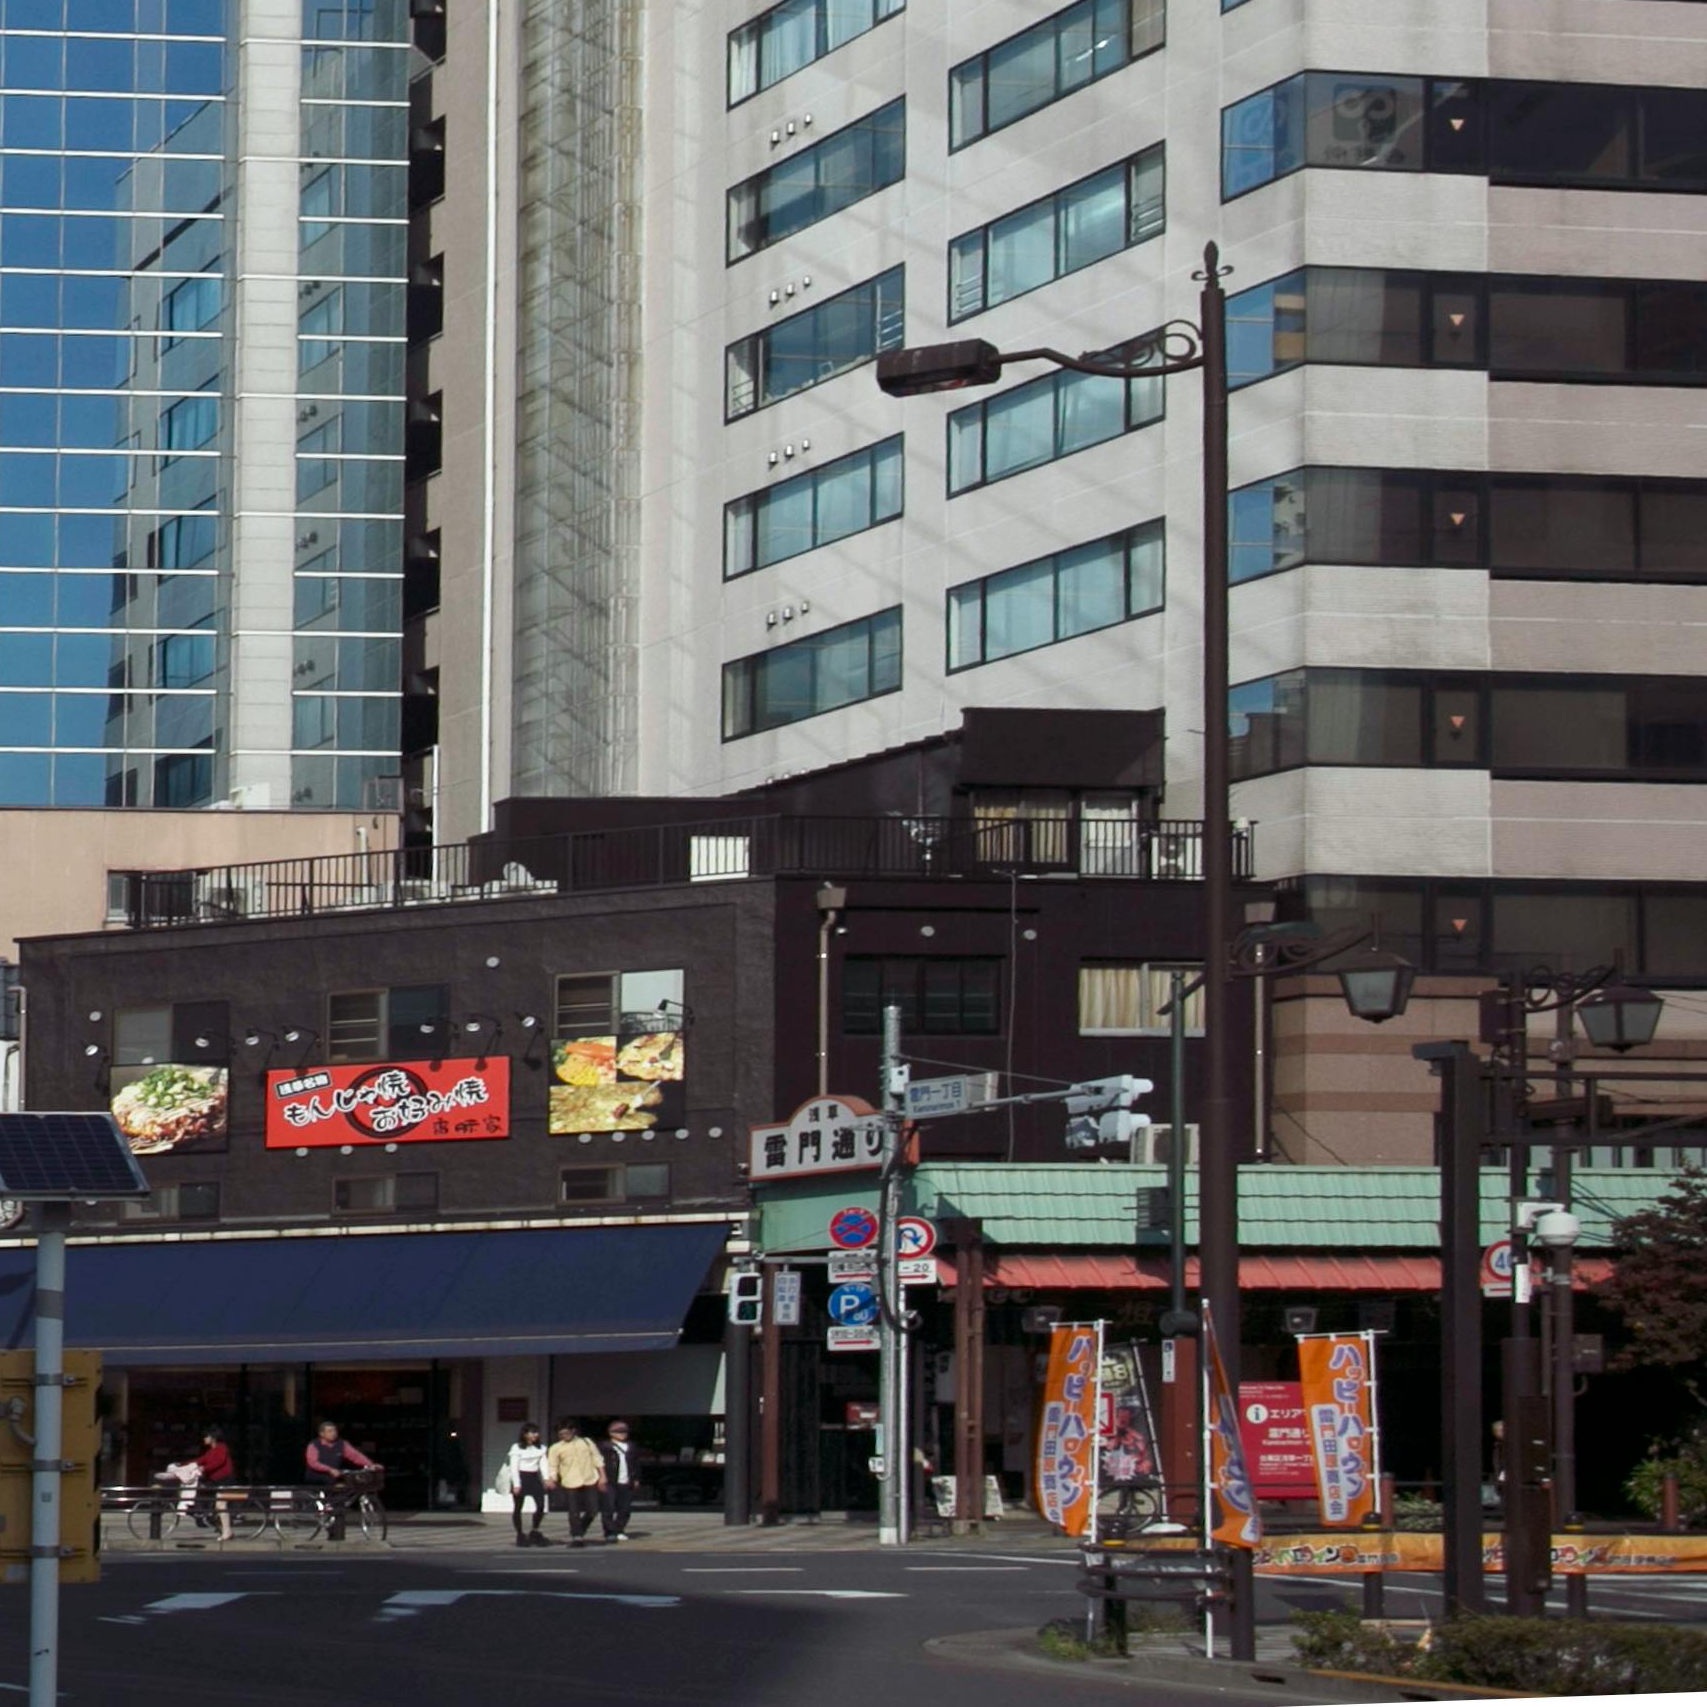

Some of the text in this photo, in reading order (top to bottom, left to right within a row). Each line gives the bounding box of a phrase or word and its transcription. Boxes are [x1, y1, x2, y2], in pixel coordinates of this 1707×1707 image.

[285, 1070, 411, 1126] もんじゃ焼
[370, 1076, 489, 1132] お好み焼
[763, 1123, 885, 1169] 雷門通り
[839, 1294, 861, 1317] P
